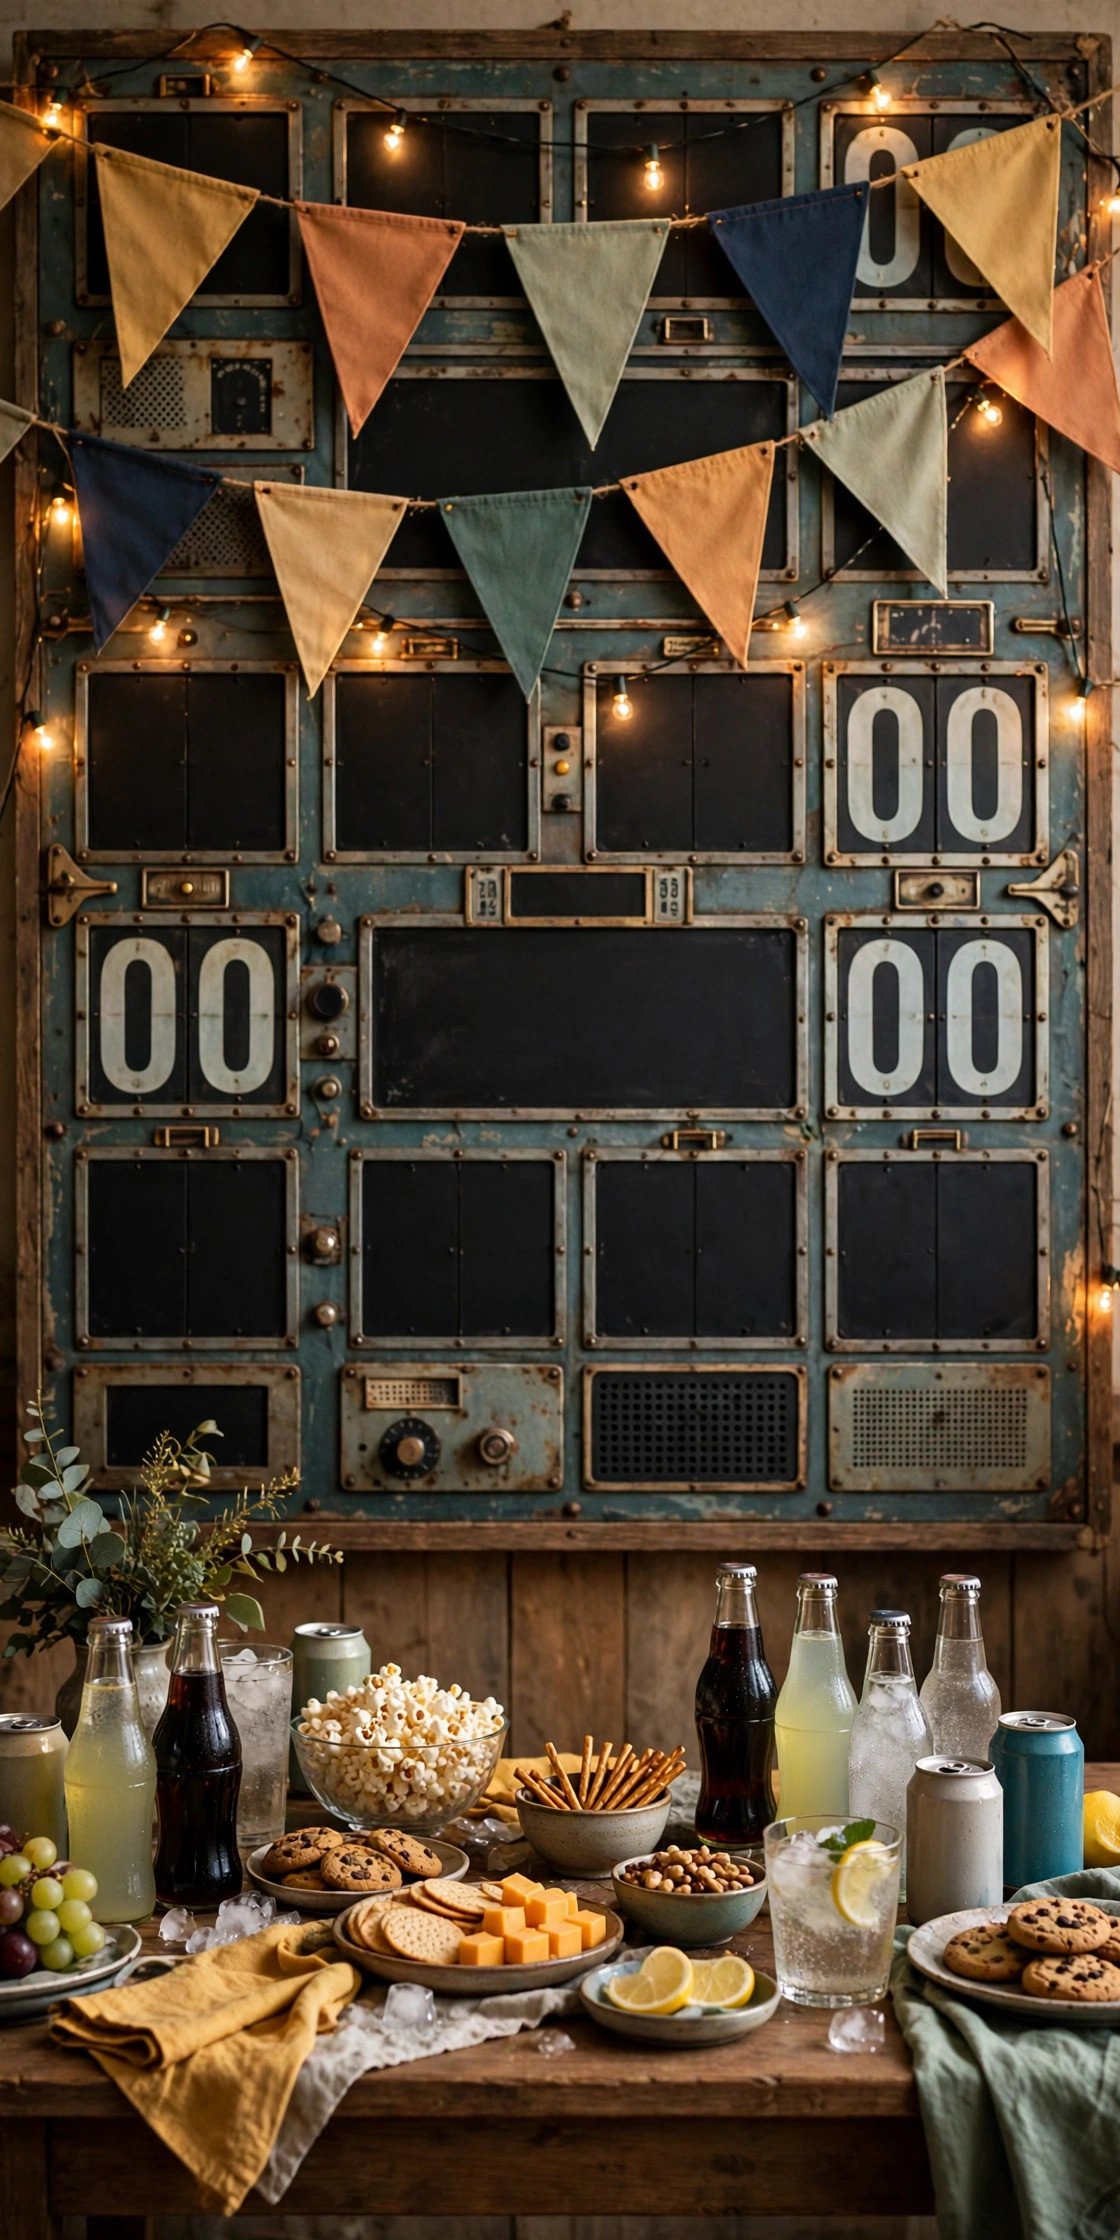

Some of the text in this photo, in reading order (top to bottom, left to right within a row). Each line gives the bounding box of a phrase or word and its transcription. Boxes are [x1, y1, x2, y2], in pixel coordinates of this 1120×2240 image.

[844, 126, 1002, 287] 0
[846, 685, 1023, 843] 00
[100, 937, 275, 1094] 00
[847, 938, 1023, 1097] 00
